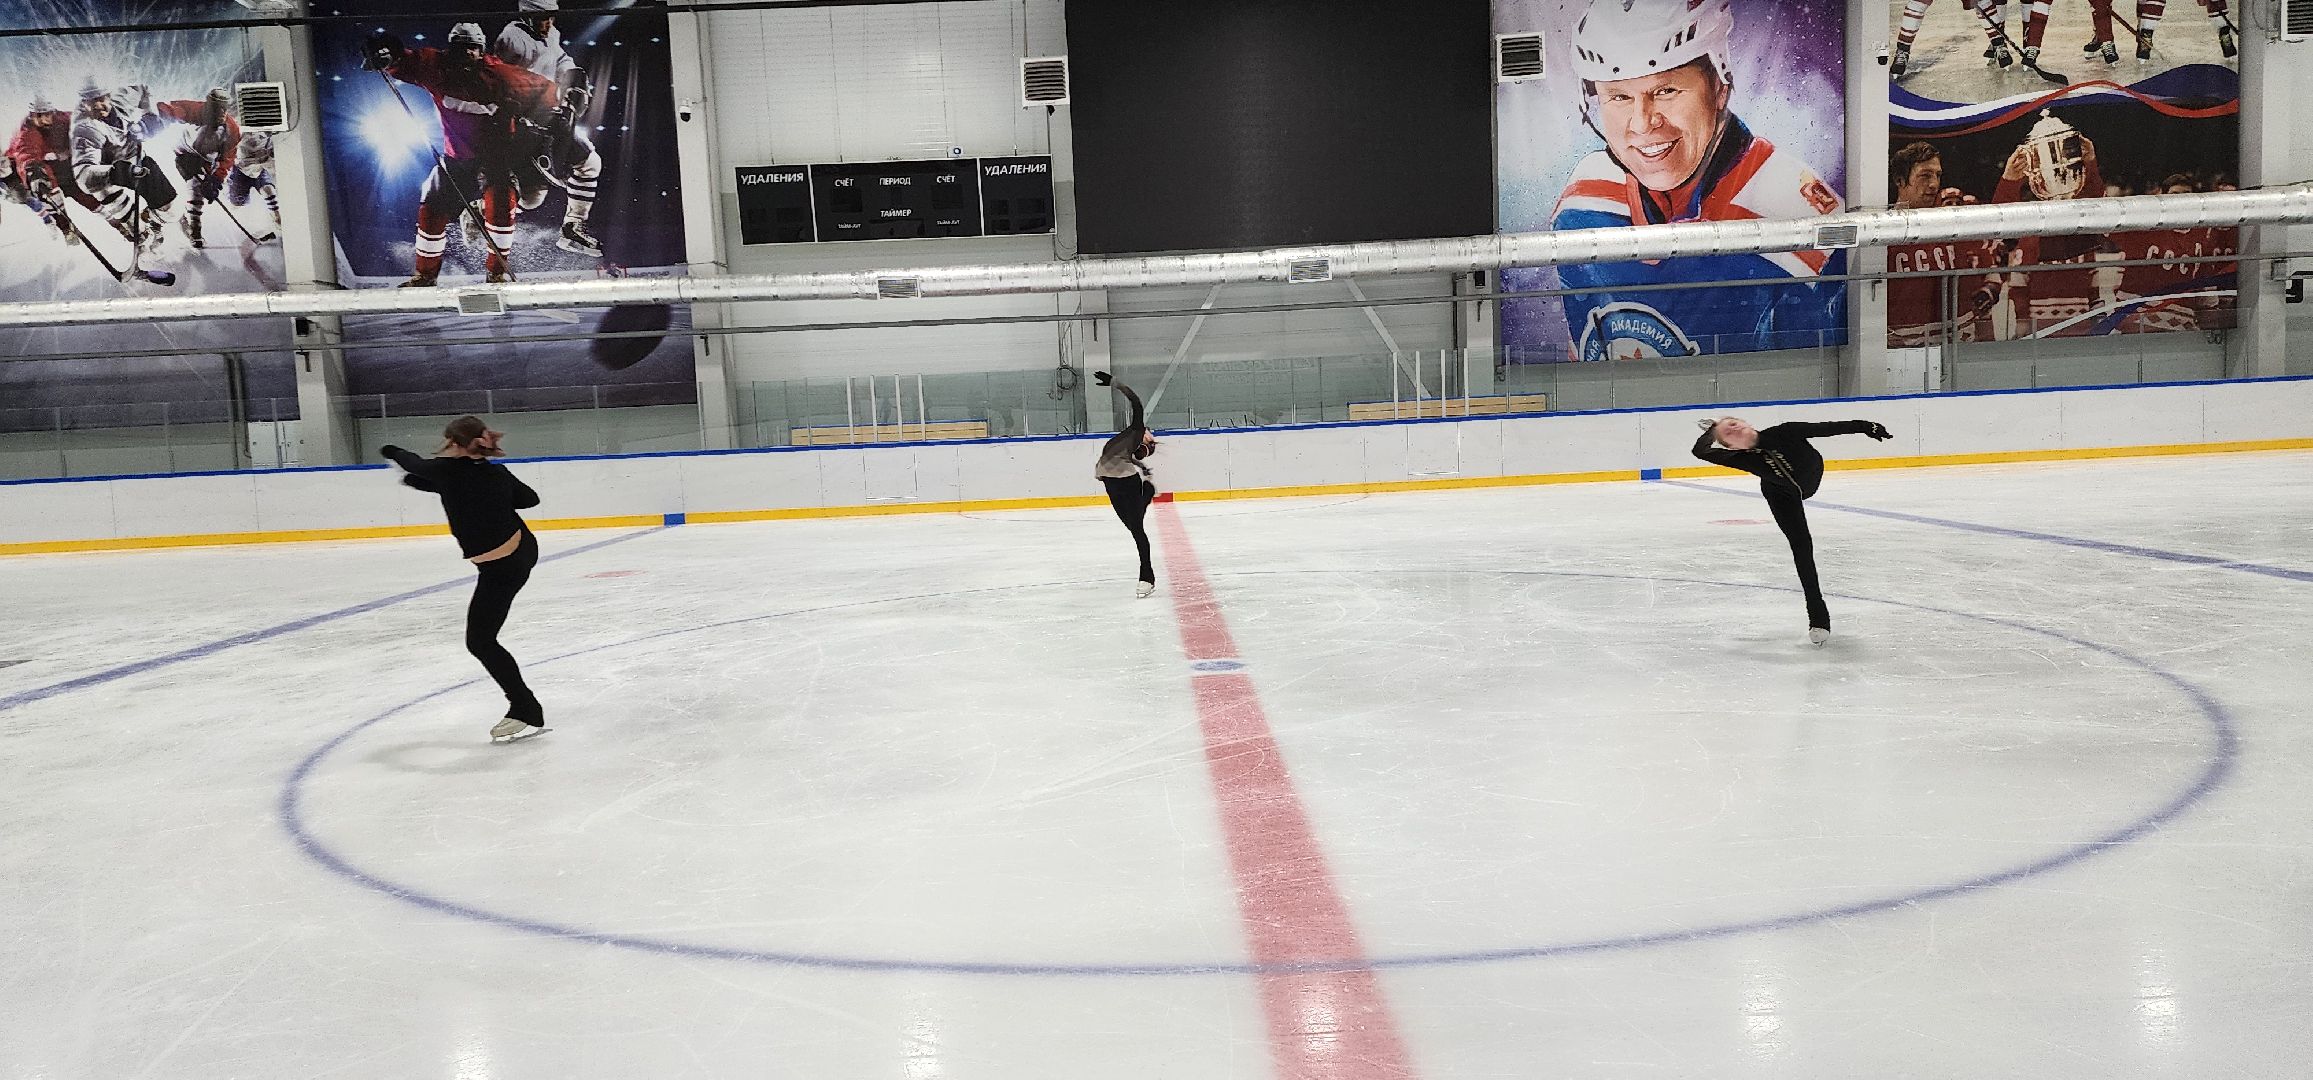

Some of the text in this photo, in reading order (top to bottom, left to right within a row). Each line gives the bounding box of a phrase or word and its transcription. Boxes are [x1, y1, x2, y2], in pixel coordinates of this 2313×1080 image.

[984, 163, 1047, 176] УДАЛЕНИЯ
[741, 172, 804, 186] УДАЛЕНИЯ
[834, 177, 854, 187] СЧЁТ
[879, 177, 911, 186] ПЕРИОД
[936, 173, 956, 183] СЧЁТ
[880, 208, 912, 218] ТАЙМЕР
[1611, 319, 1673, 350] АКАДЕМИЯ
